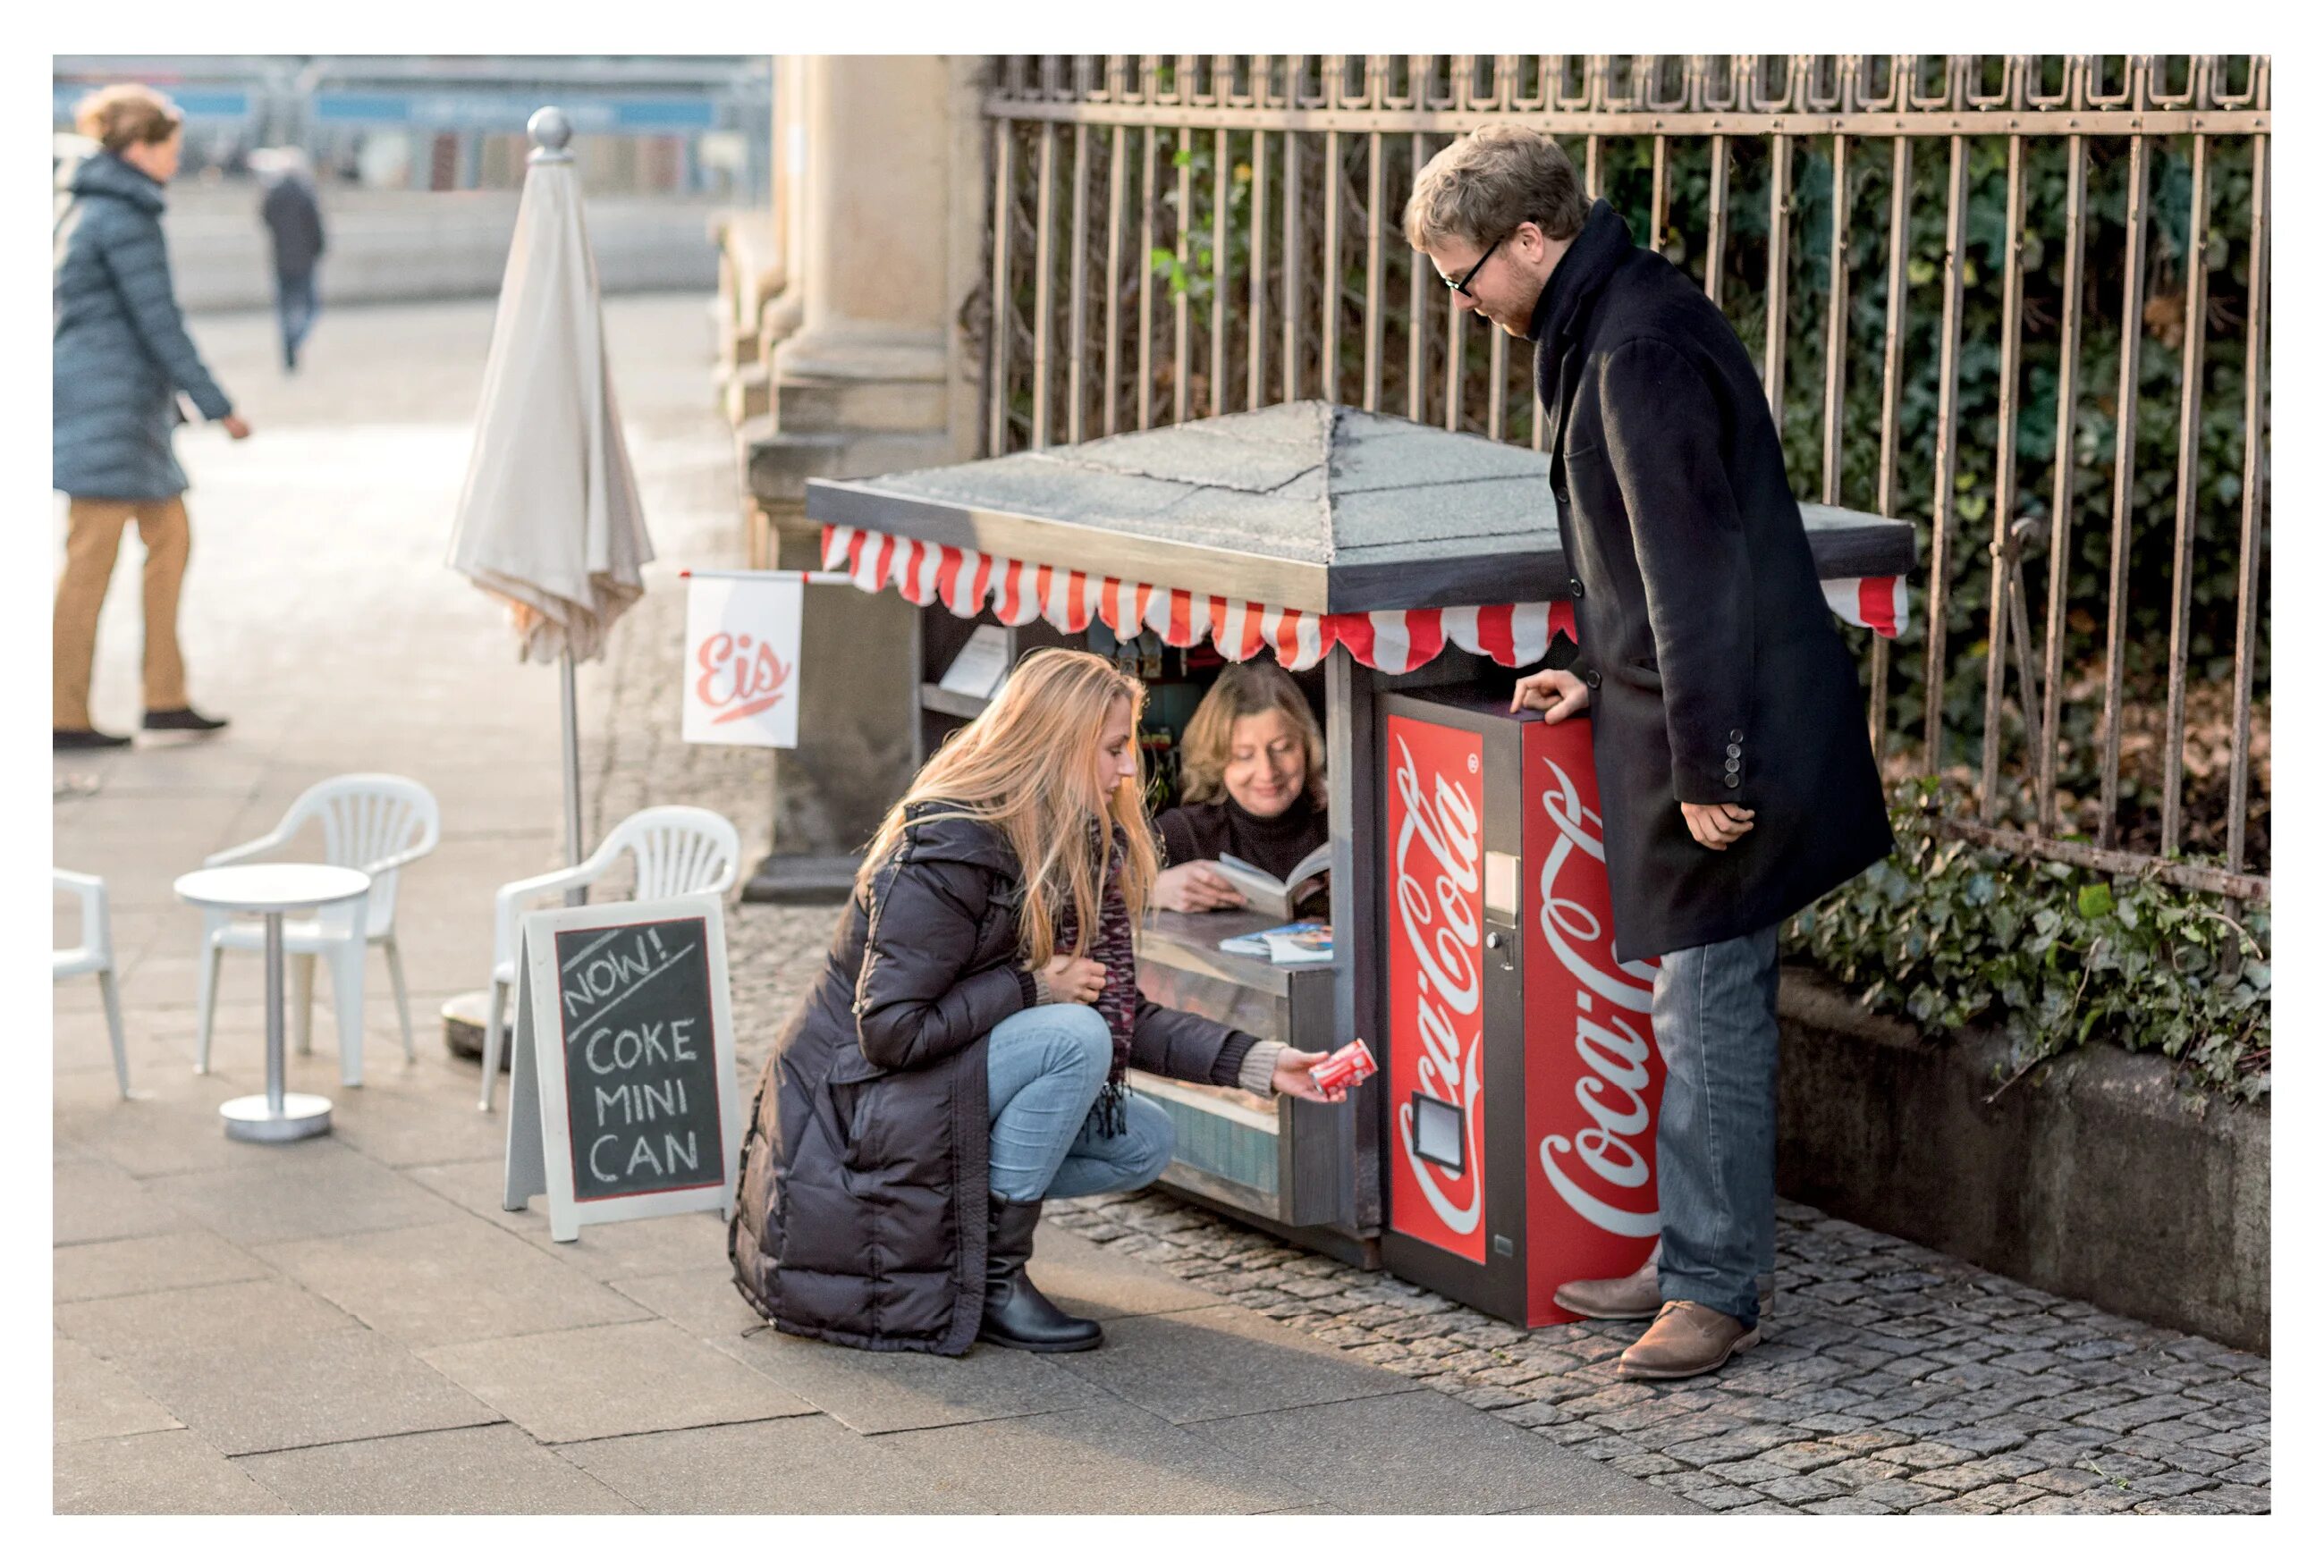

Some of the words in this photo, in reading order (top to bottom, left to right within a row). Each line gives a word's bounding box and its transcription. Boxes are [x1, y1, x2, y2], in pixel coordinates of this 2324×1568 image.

[697, 632, 791, 707] Eis
[563, 927, 668, 1017] NOW!
[1395, 731, 1482, 1235] Cca-Cola
[586, 1017, 697, 1075] COKE
[595, 1078, 688, 1127] MINI
[589, 1130, 699, 1183] CAN
